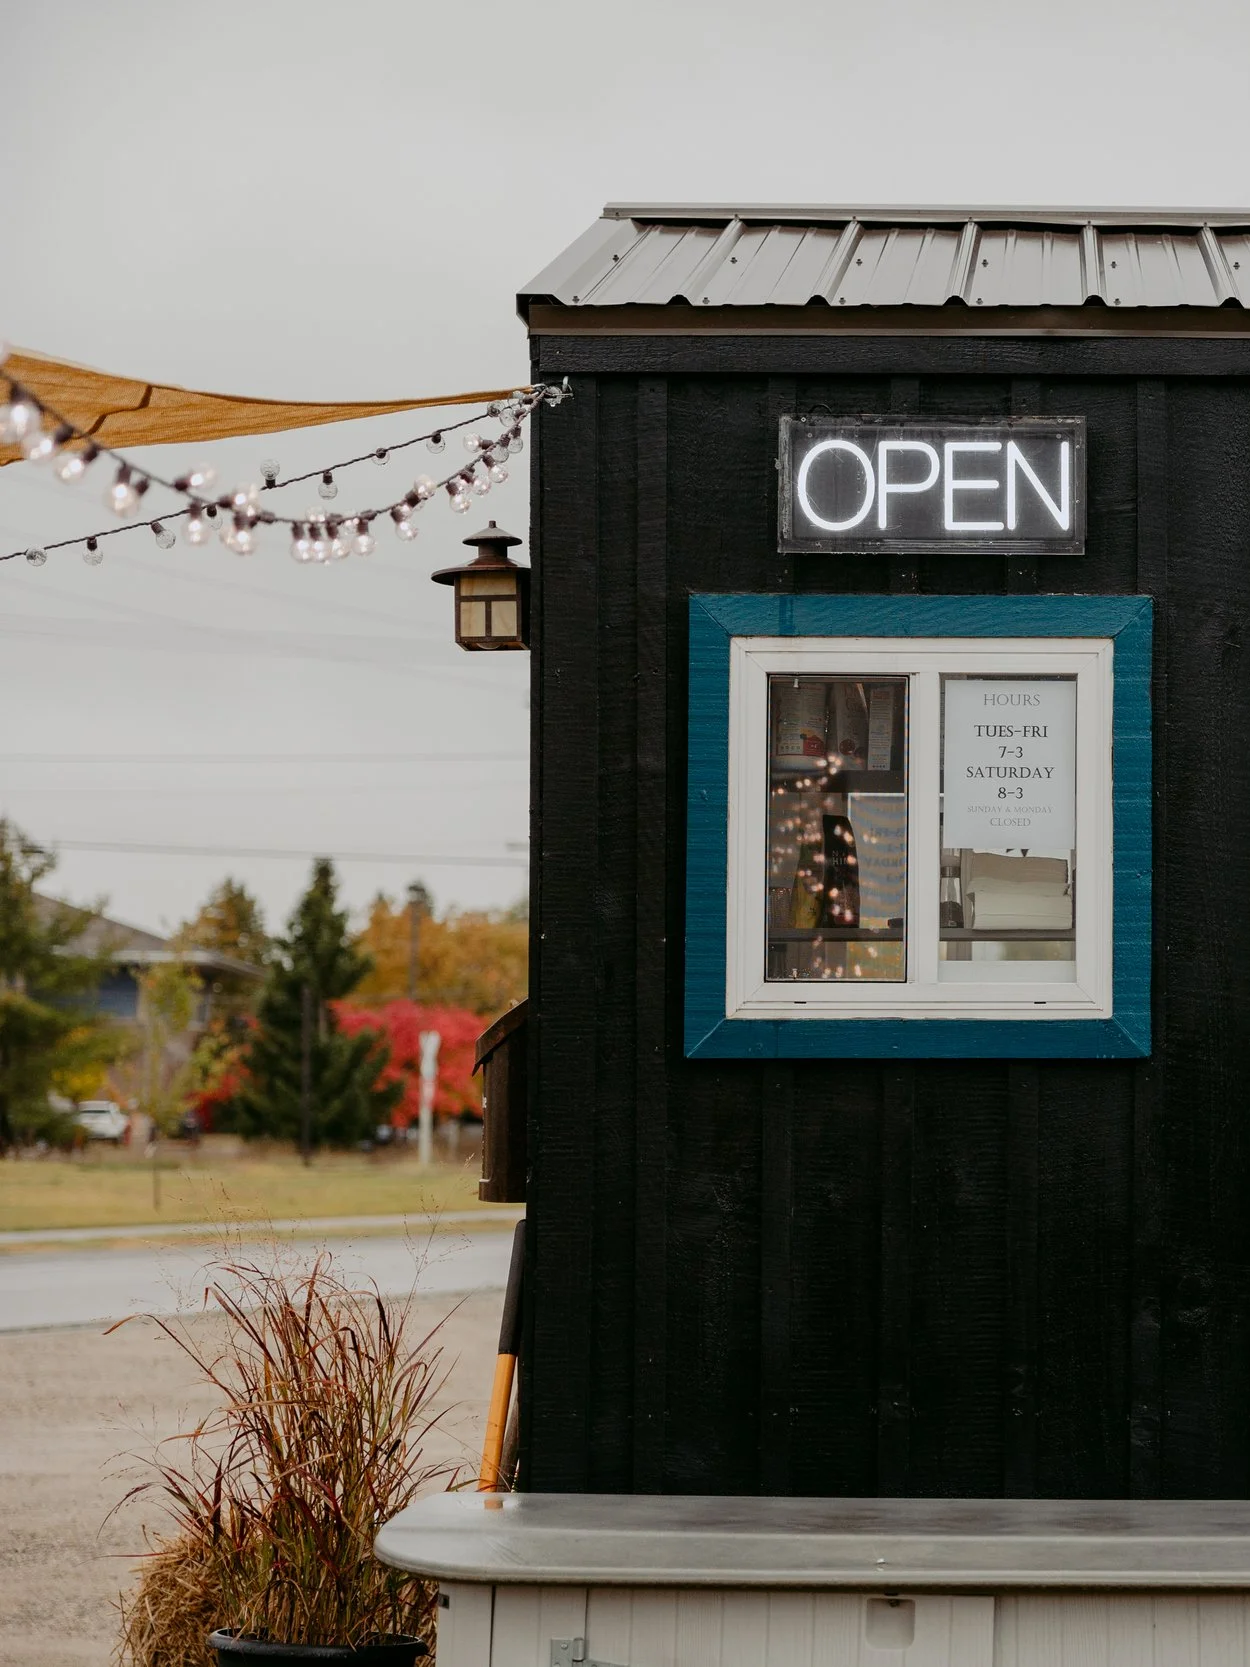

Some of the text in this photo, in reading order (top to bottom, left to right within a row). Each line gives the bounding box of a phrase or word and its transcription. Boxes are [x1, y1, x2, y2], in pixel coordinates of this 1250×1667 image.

[798, 438, 1070, 531] OPEN
[983, 693, 1041, 706] HOURS
[973, 725, 1049, 738] TUES-FRI
[998, 746, 1024, 759] 7-3
[966, 766, 1055, 779] SATURDAY
[997, 787, 1024, 799] 8-3
[967, 805, 1002, 813] SUNDAY
[989, 817, 1031, 827] CLOSED
